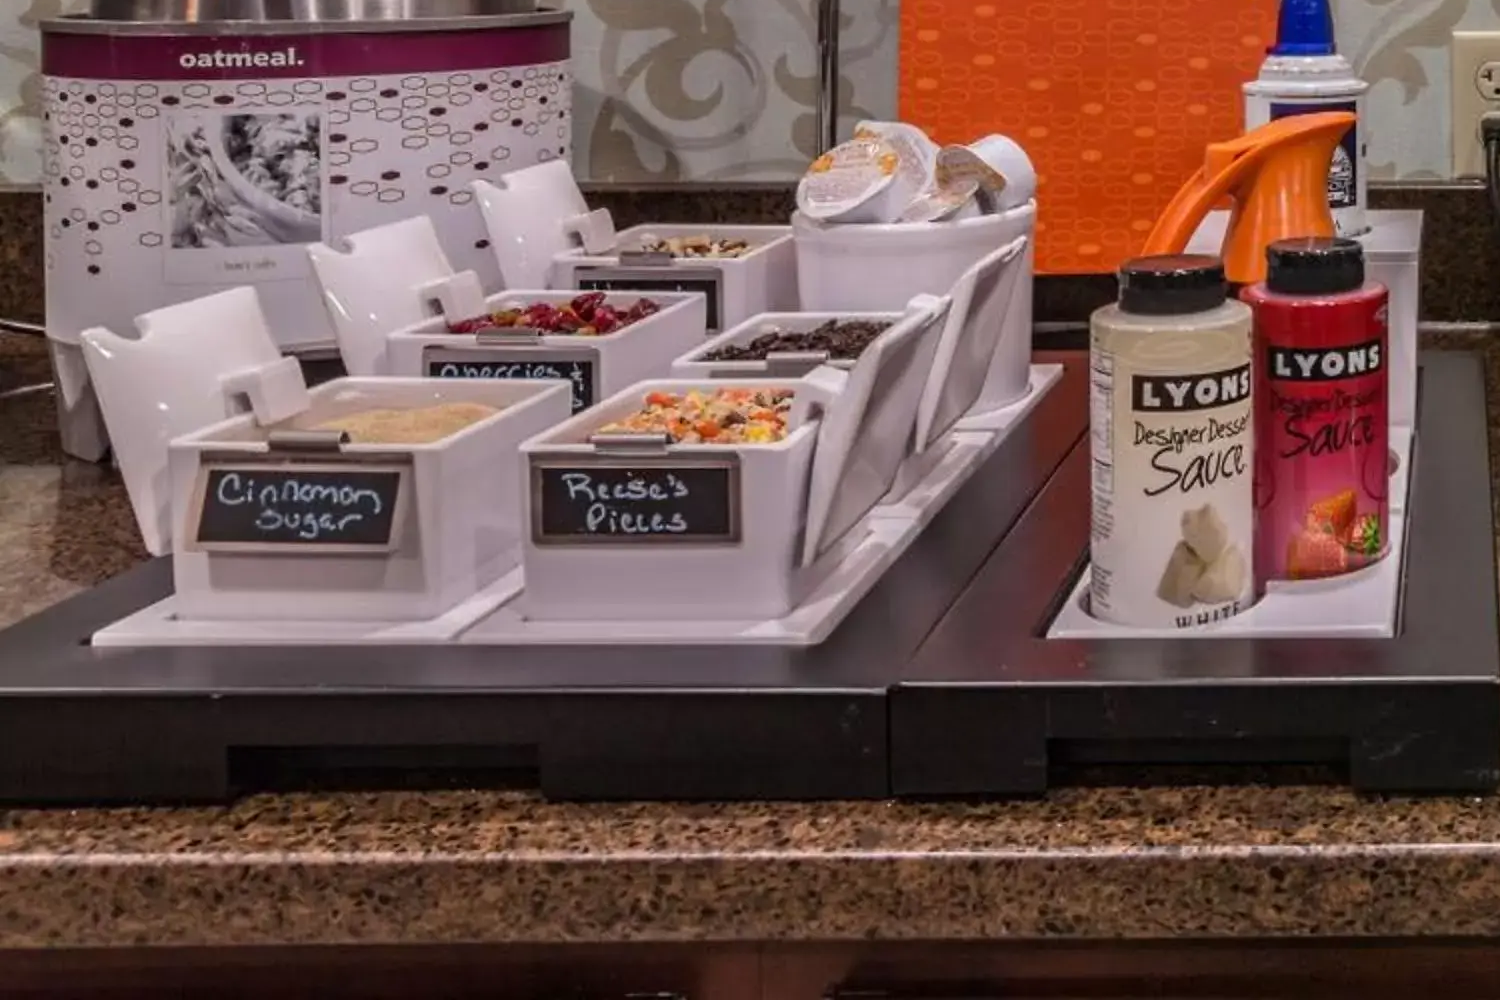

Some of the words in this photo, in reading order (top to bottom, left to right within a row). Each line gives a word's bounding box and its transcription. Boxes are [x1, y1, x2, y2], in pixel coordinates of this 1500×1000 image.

[179, 46, 305, 68] oatmeal.
[1274, 344, 1380, 378] LYONS
[1142, 370, 1250, 407] LYONS
[1133, 420, 1206, 453] Designer
[1144, 444, 1247, 497] Sauce
[255, 508, 363, 538] Sugar
